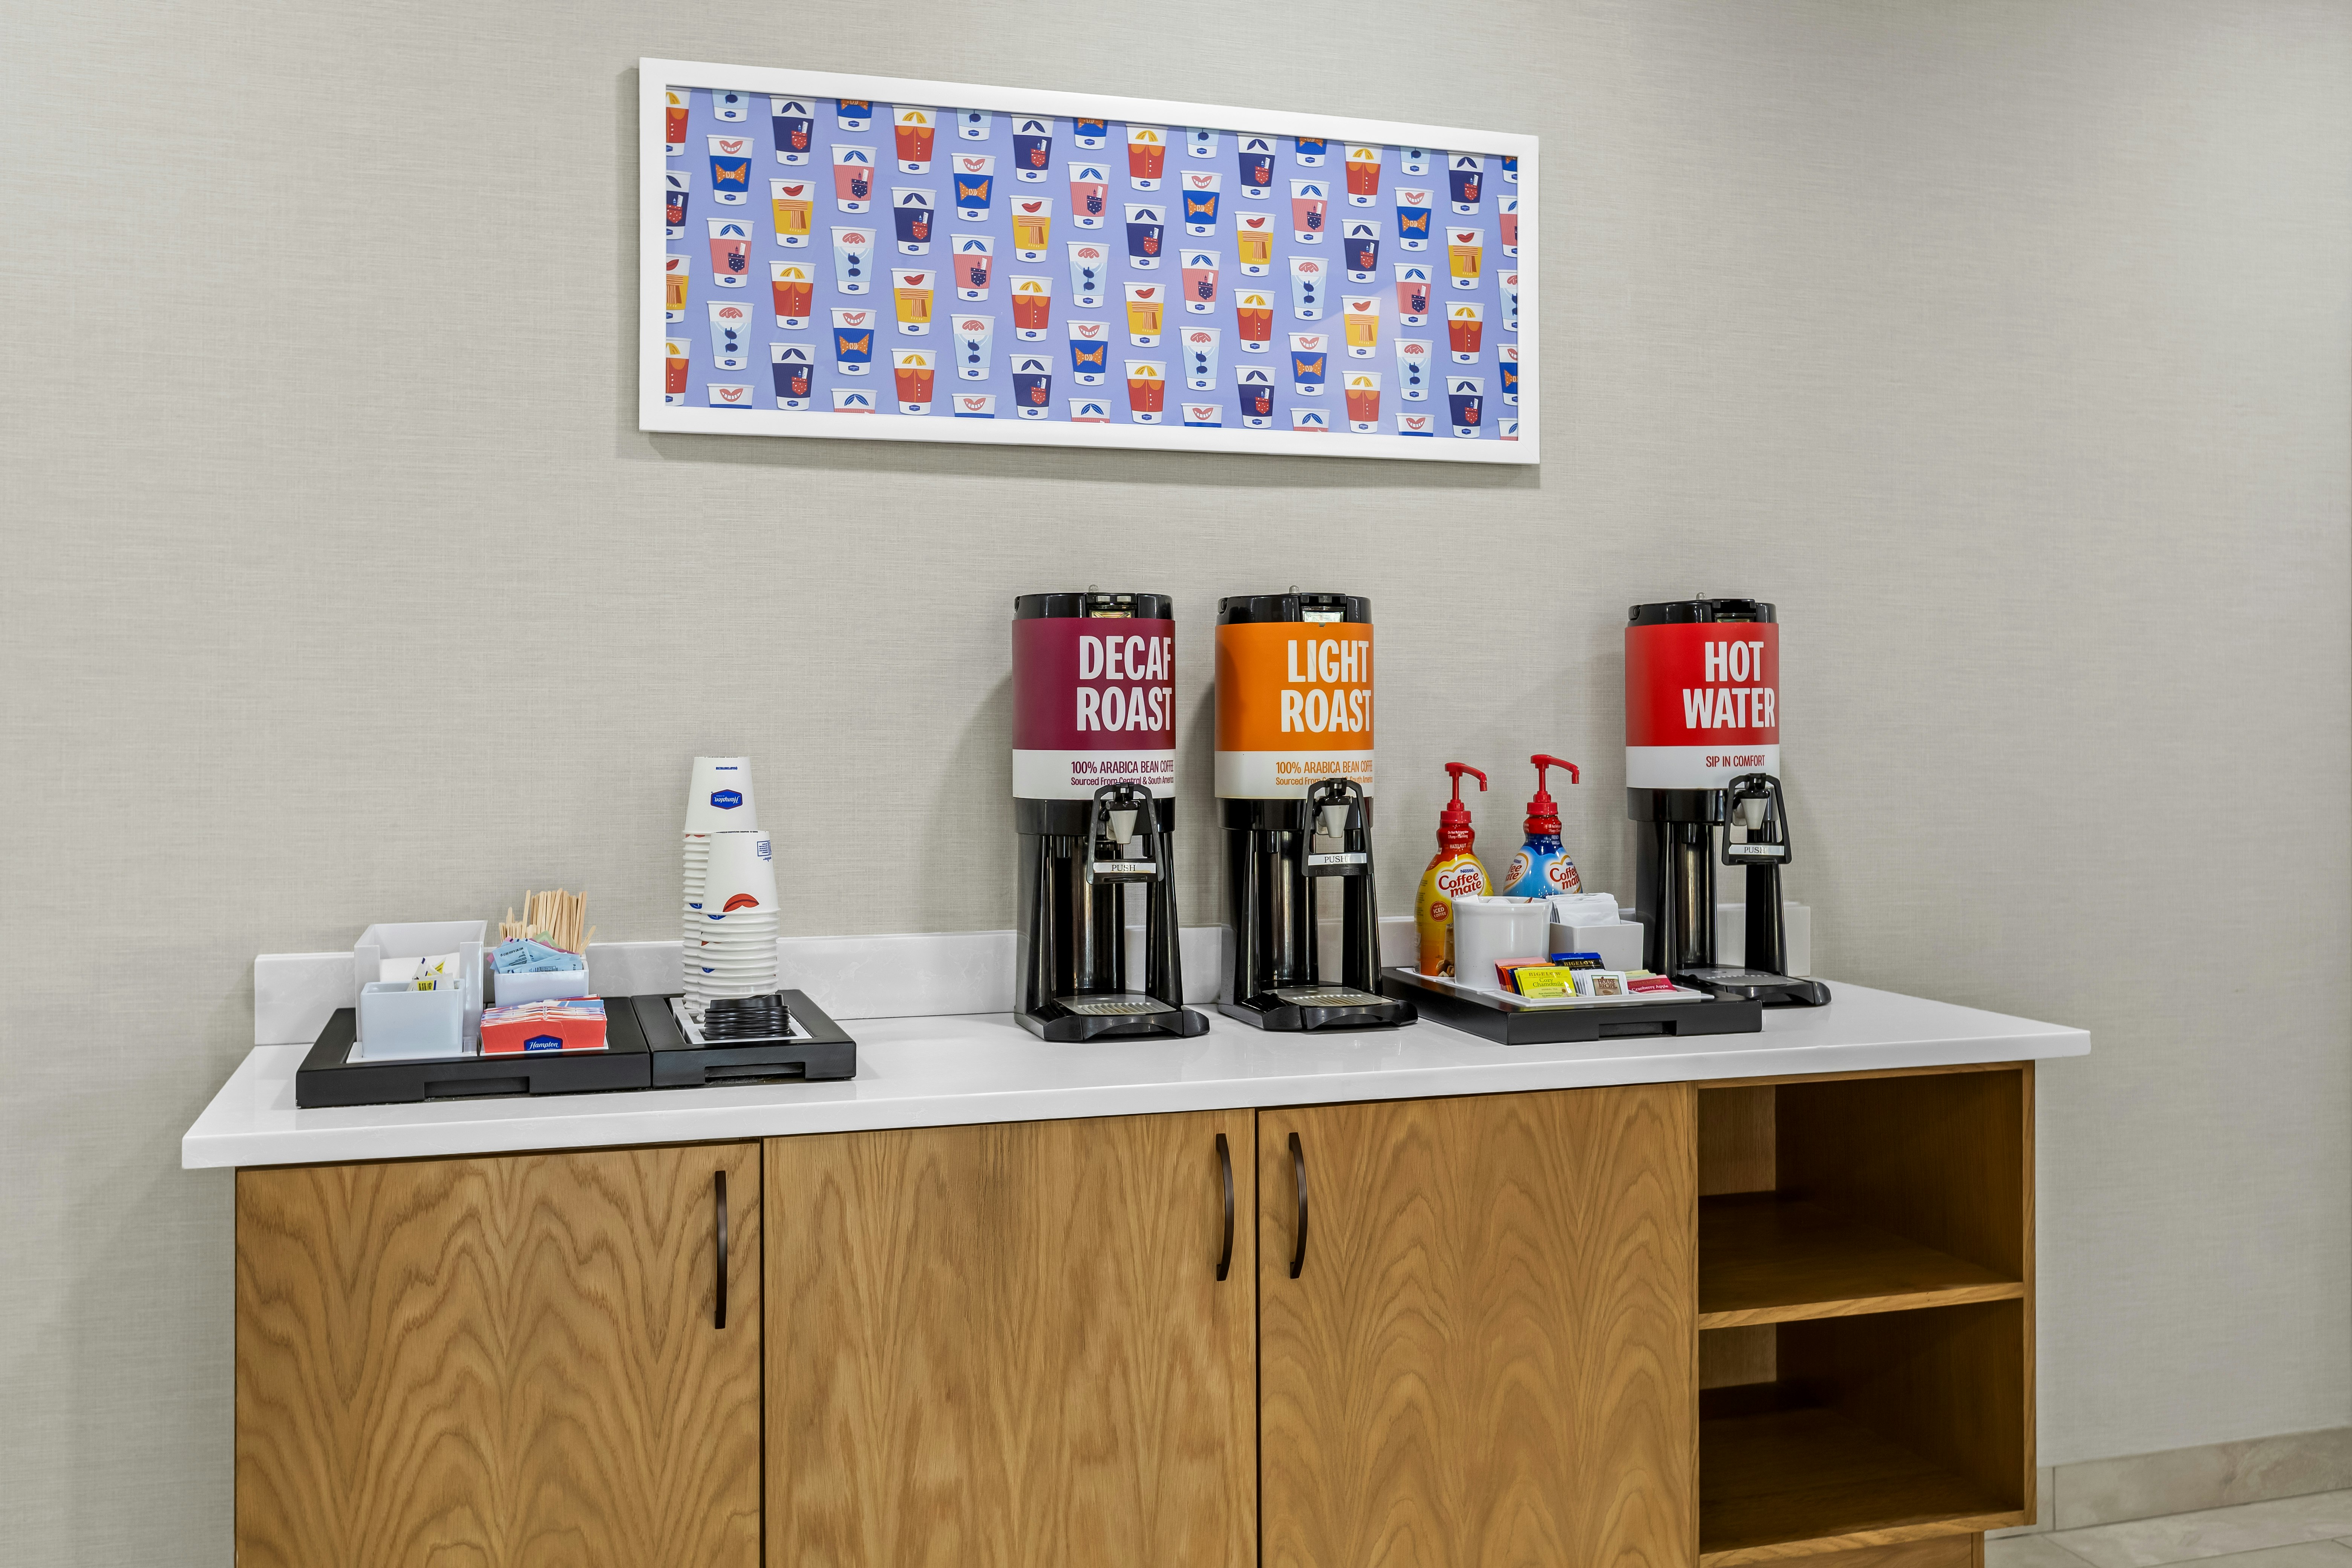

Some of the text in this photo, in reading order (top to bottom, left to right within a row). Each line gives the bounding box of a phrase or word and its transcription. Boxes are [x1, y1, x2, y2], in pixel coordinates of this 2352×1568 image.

[1080, 635, 1171, 680] DECAF
[1288, 639, 1369, 683] LIGHT
[1705, 640, 1764, 682] HOT
[1077, 686, 1172, 731] ROAST
[1281, 689, 1371, 733] ROAST
[1683, 688, 1775, 729] WATER
[1071, 760, 1174, 774] 100% ARABICA BEAN COFFEE
[1276, 760, 1373, 773] 100% ARABICA BEAN COFFEE
[1706, 755, 1765, 767] SIP IN COMFORT
[1071, 776, 1099, 786] Sourced
[1100, 777, 1118, 786] From
[1142, 776, 1147, 785] &
[1148, 776, 1162, 784] South
[1276, 777, 1303, 785] Sourced
[714, 796, 740, 804] Hampton
[1438, 873, 1479, 890] Coffee
[1550, 866, 1577, 882] Coffee
[1562, 873, 1580, 890] mate
[1450, 880, 1482, 898] mate
[527, 1041, 559, 1050] Hampton
